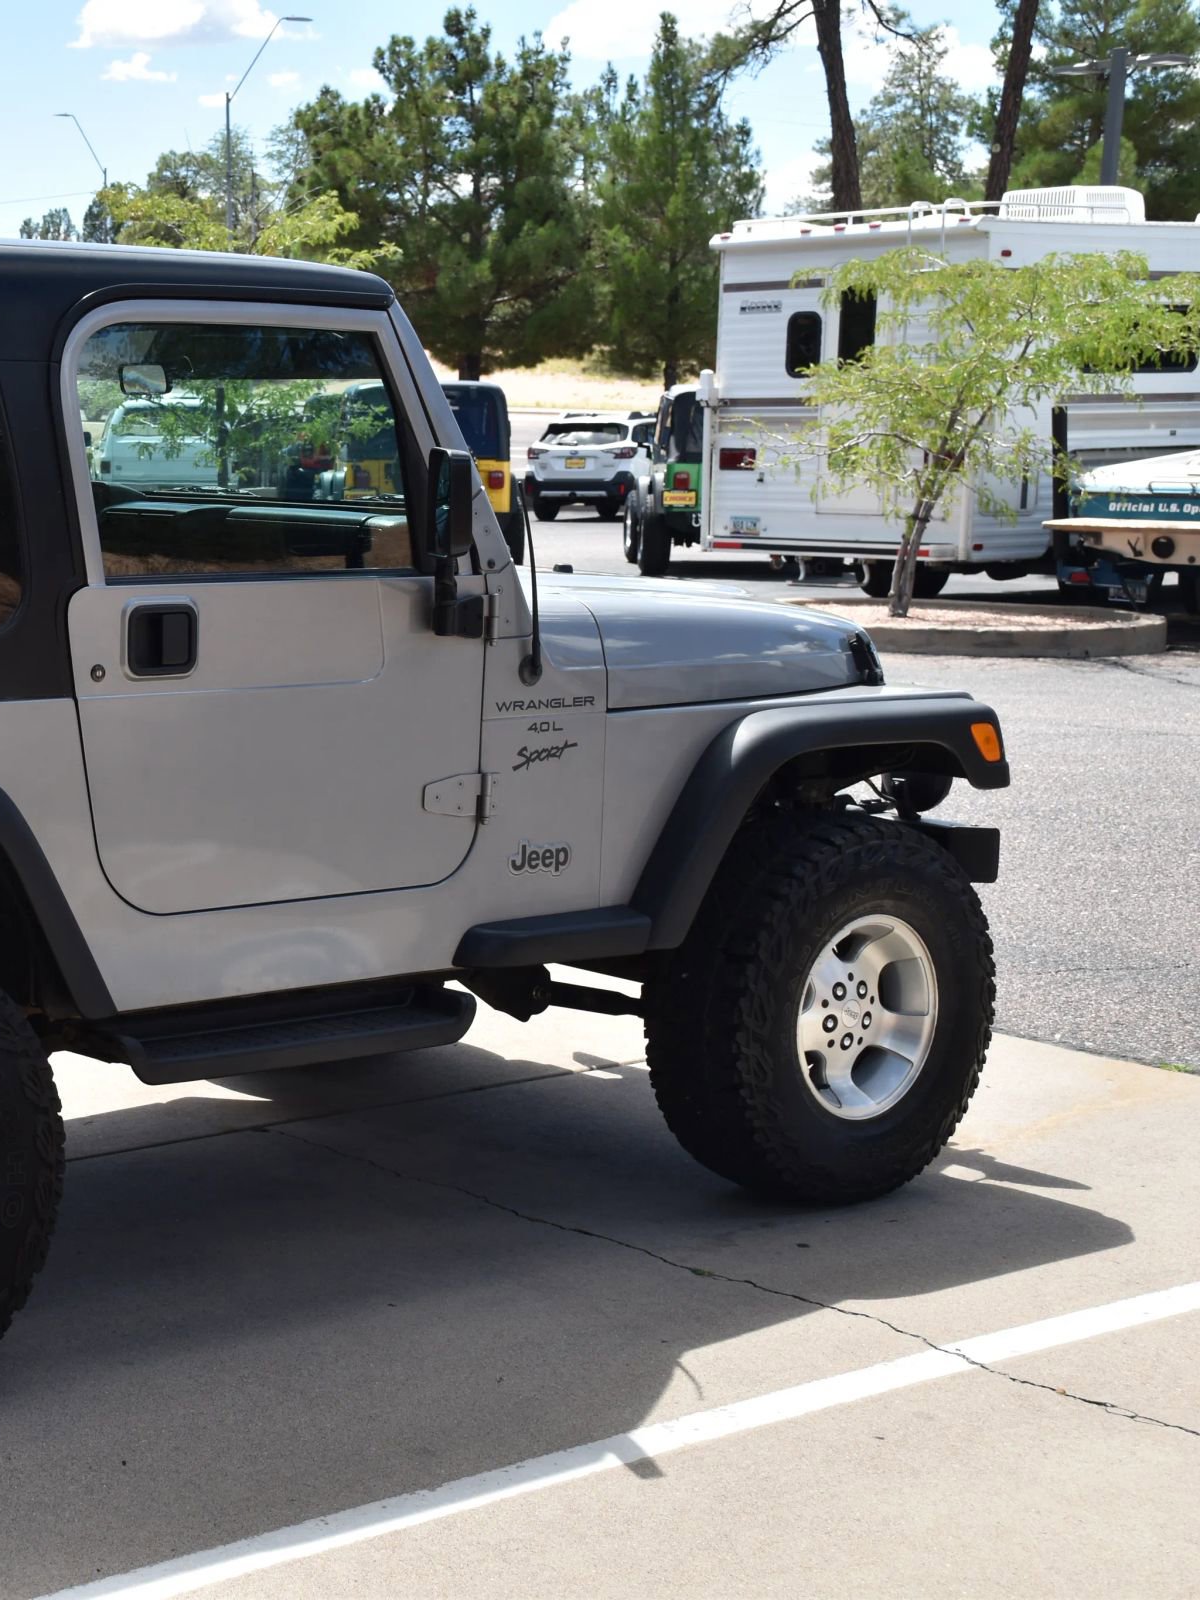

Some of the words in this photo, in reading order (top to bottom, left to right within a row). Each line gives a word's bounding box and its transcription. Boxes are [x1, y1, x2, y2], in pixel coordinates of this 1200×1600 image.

[1108, 502, 1155, 512] Official
[1158, 503, 1180, 513] U.S.
[1183, 503, 1200, 515] Op
[495, 696, 595, 713] WRANGLER
[510, 843, 569, 874] Jeep
